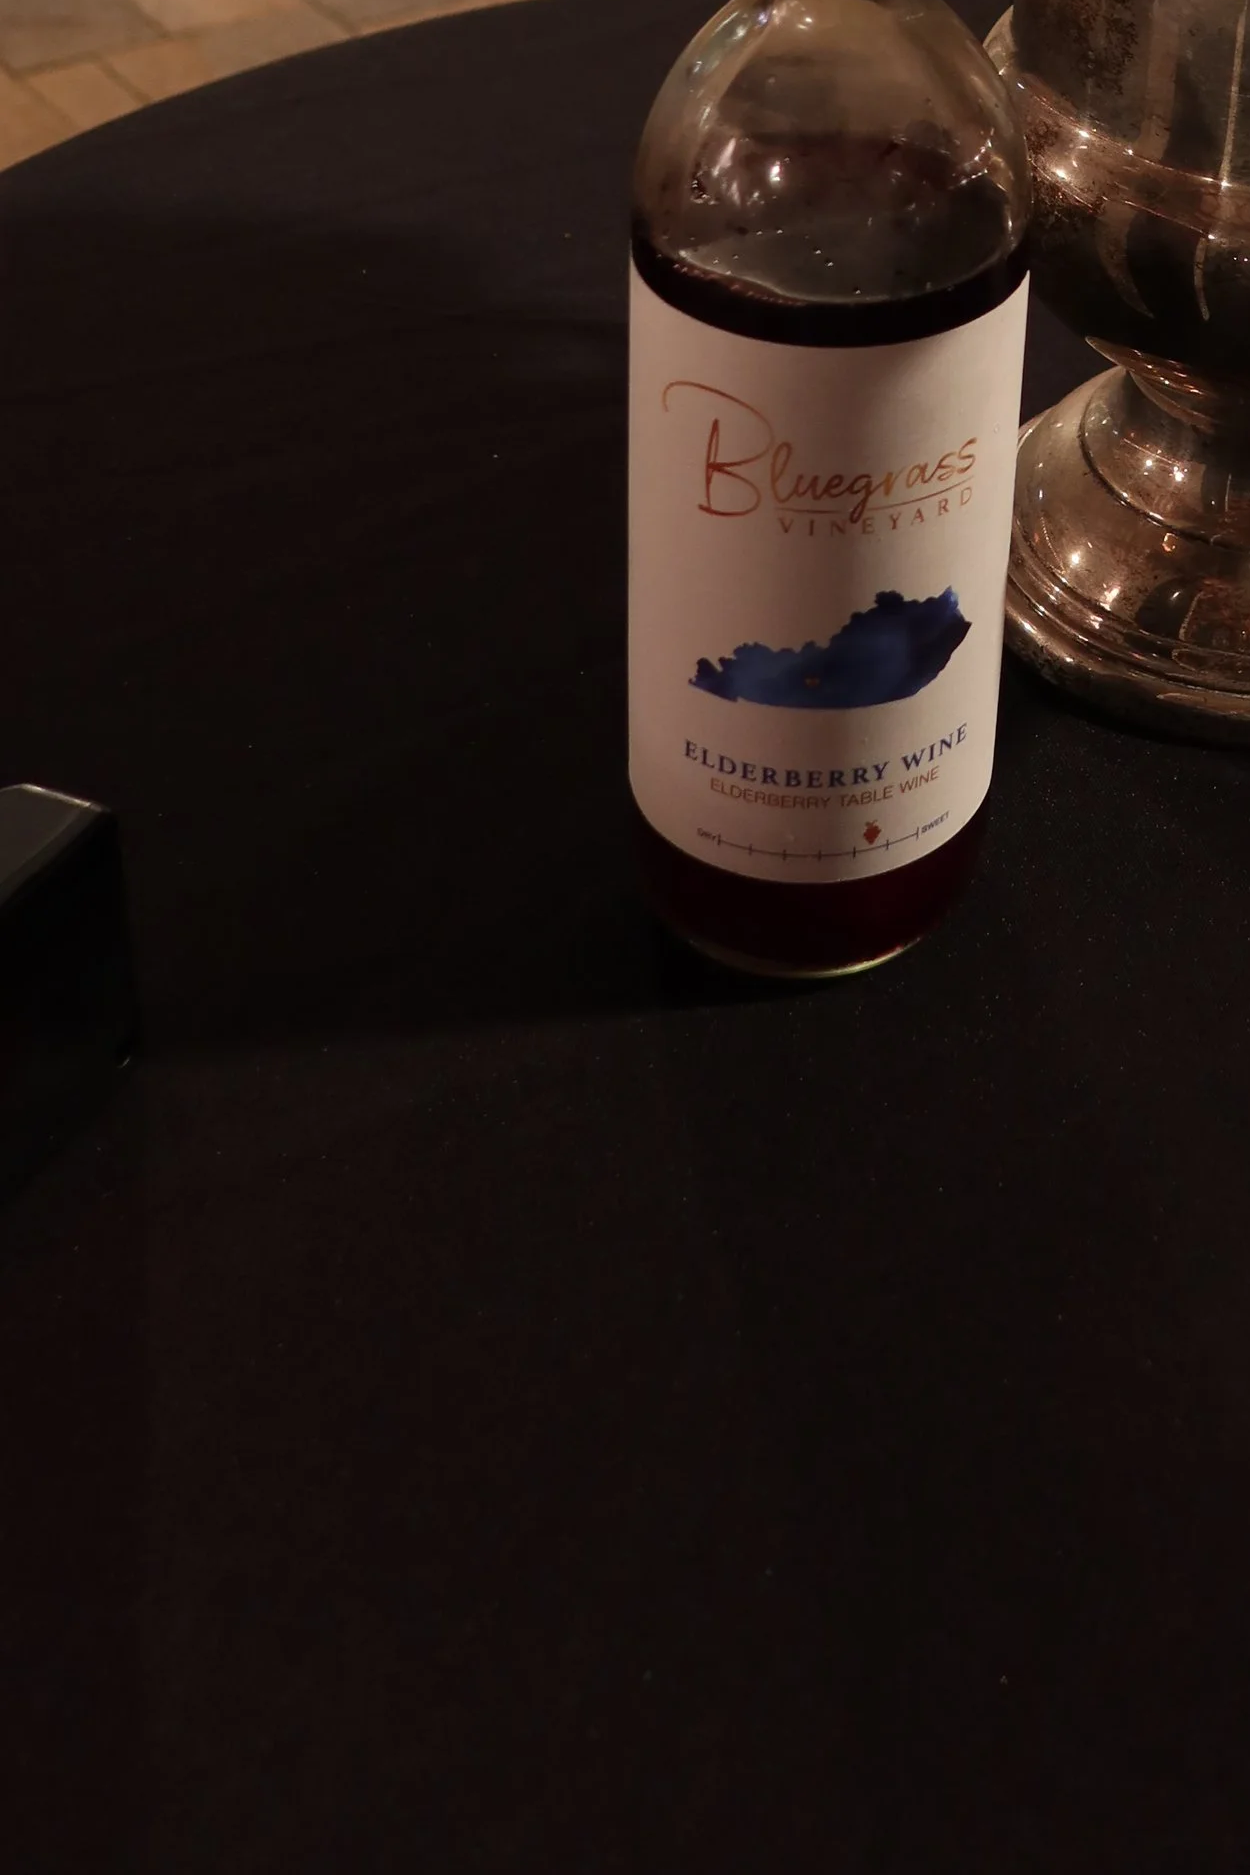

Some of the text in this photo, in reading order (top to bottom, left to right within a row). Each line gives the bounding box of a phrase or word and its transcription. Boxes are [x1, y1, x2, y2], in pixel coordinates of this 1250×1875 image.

[661, 380, 977, 524] Bluegrass
[777, 485, 974, 537] VINEYARD
[684, 722, 968, 790] ELDERBERRY WINE
[709, 764, 941, 810] ELDERBERRY TABLE WINE
